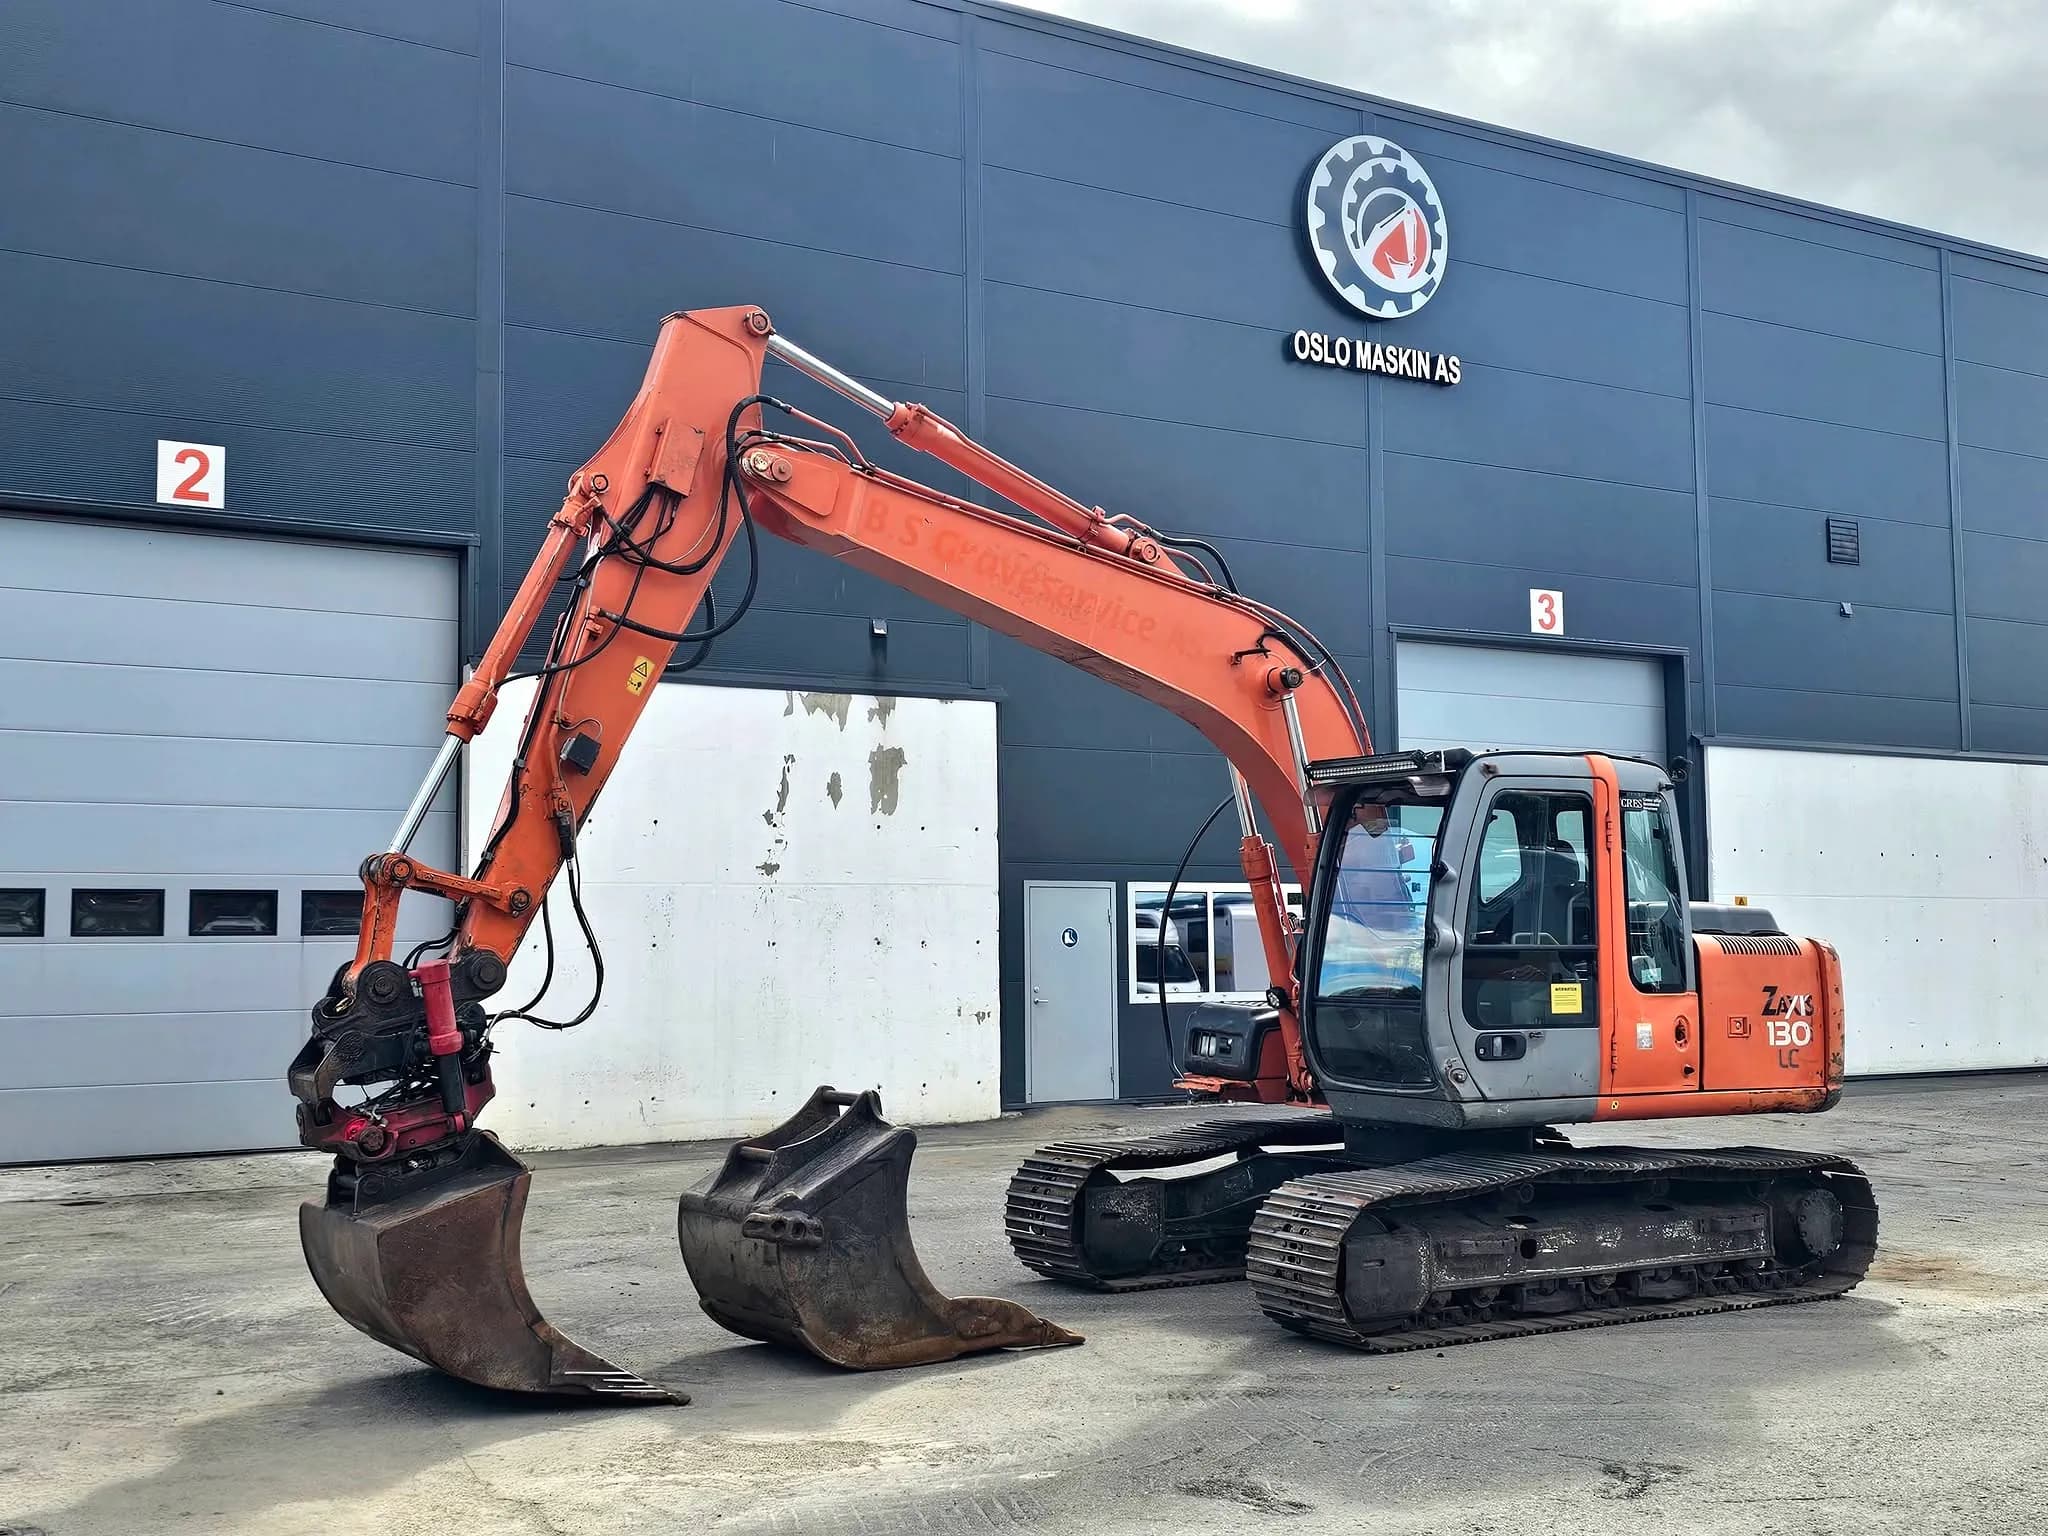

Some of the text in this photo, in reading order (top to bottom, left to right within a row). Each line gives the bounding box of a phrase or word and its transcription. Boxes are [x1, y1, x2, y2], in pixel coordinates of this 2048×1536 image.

[1293, 329, 1463, 385] OSLO MASKIN AS
[172, 448, 210, 502] 2
[1538, 593, 1556, 631] 3
[1620, 798, 1643, 809] CRES
[1766, 1020, 1812, 1047] 130
[1778, 1048, 1800, 1069] LC
